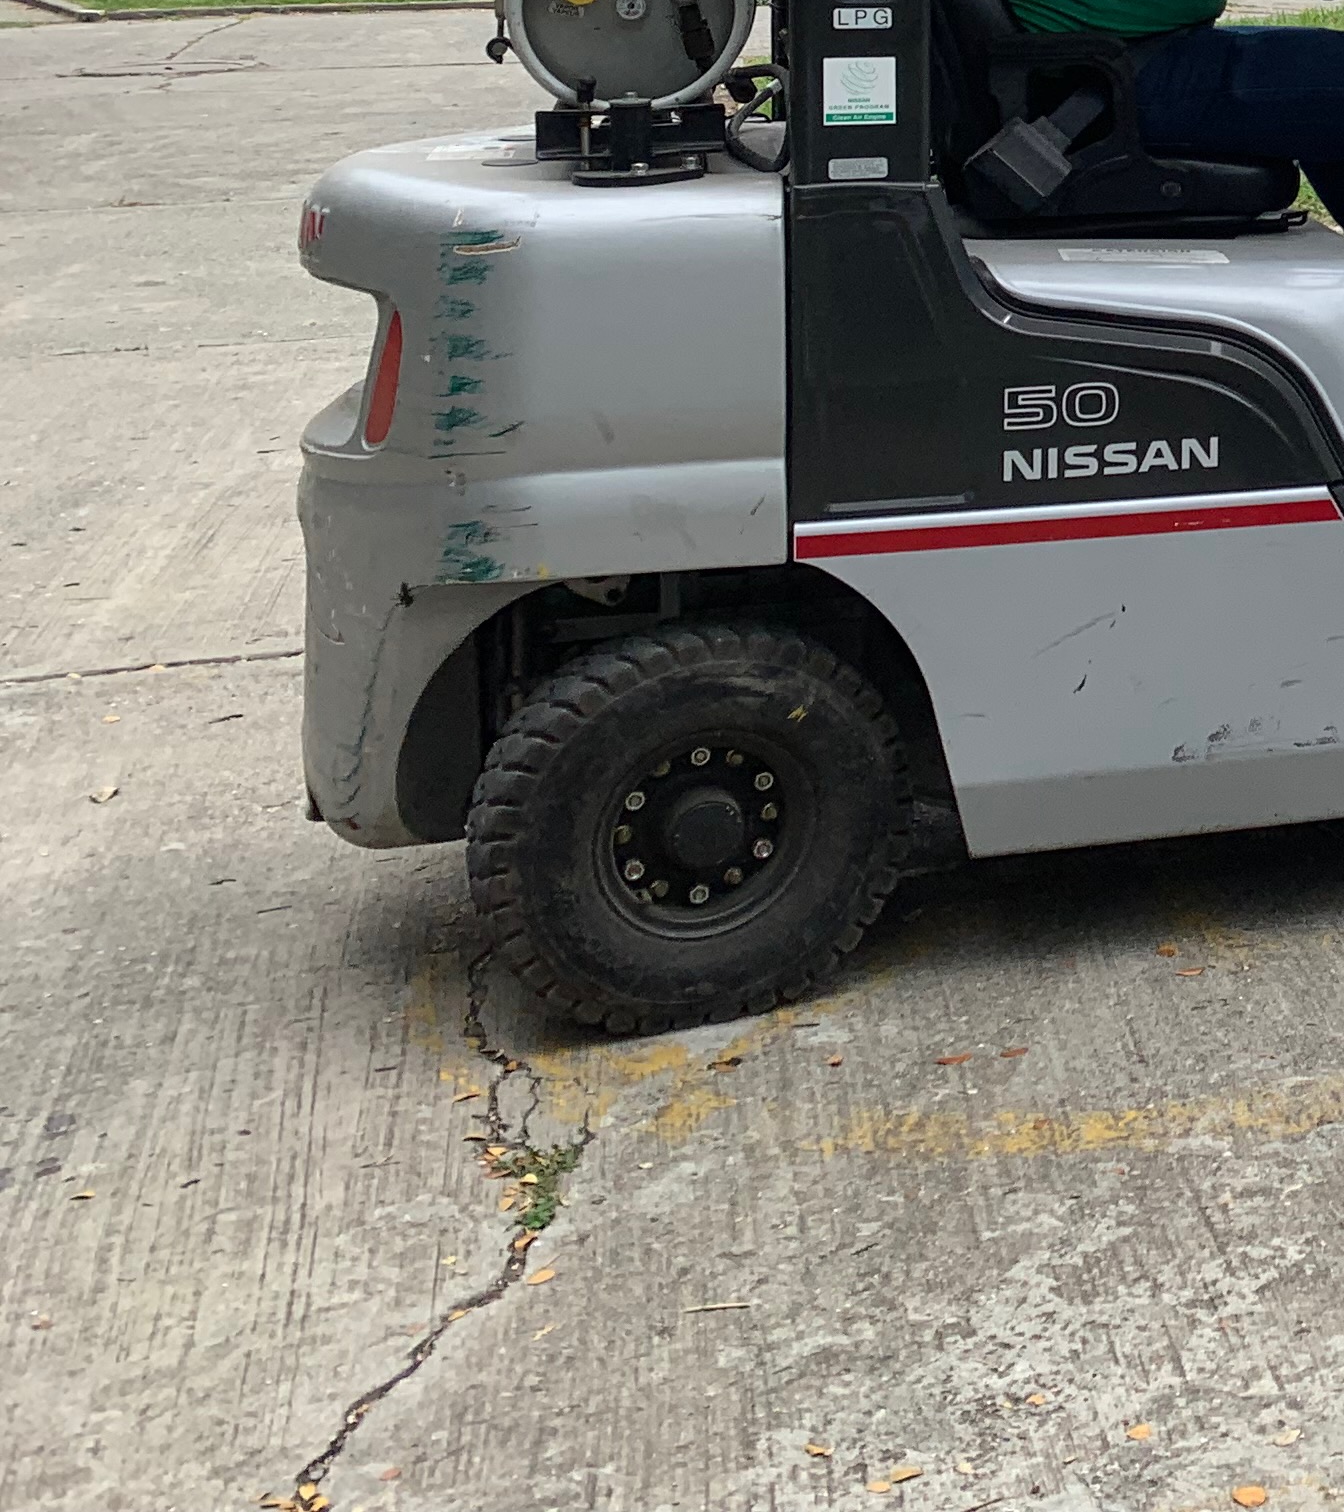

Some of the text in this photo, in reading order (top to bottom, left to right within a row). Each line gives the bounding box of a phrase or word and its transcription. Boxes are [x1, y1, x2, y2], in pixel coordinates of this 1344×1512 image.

[837, 9, 889, 26] LPG
[1003, 382, 1119, 431] 50
[1003, 436, 1219, 483] NISSAN
